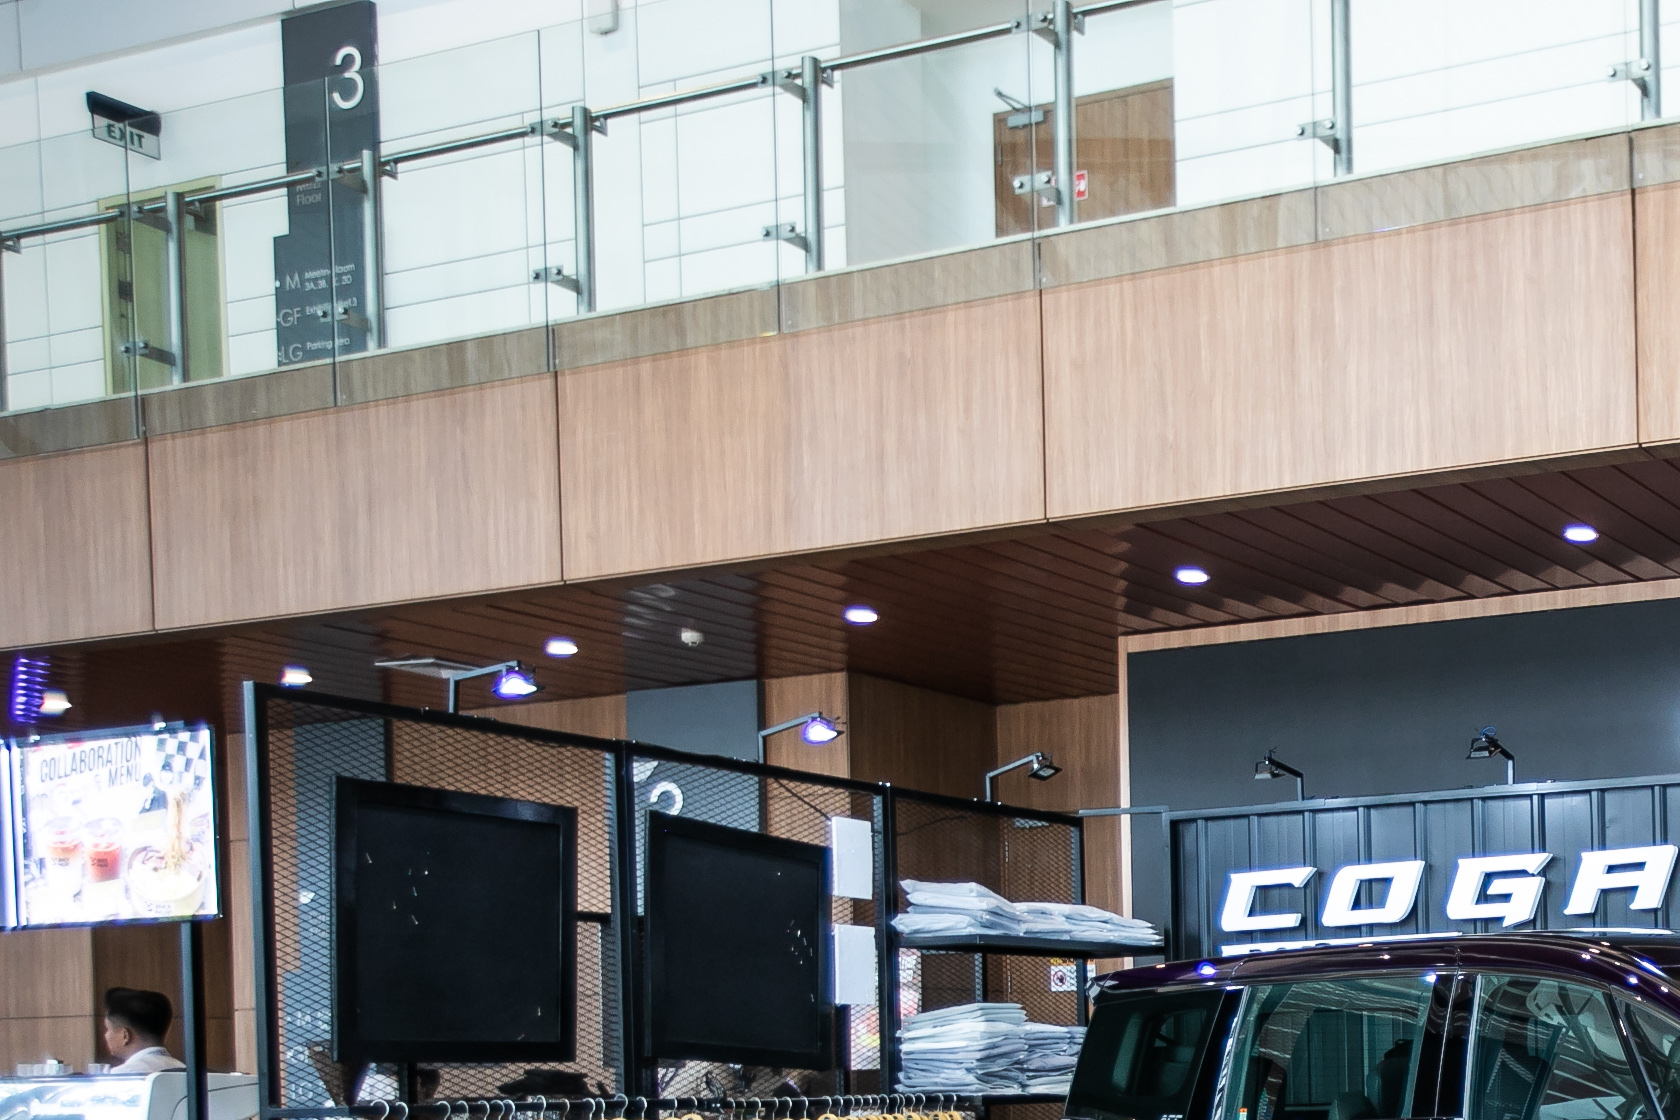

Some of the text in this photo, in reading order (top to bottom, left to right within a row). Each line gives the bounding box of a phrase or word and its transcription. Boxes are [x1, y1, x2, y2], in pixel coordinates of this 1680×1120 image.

[332, 46, 364, 110] 3
[286, 271, 301, 290] M
[280, 307, 301, 327] GF
[282, 343, 303, 363] LG
[39, 737, 142, 783] COLLABORATION
[107, 762, 142, 788] MENU
[1221, 844, 1679, 932] COGA
